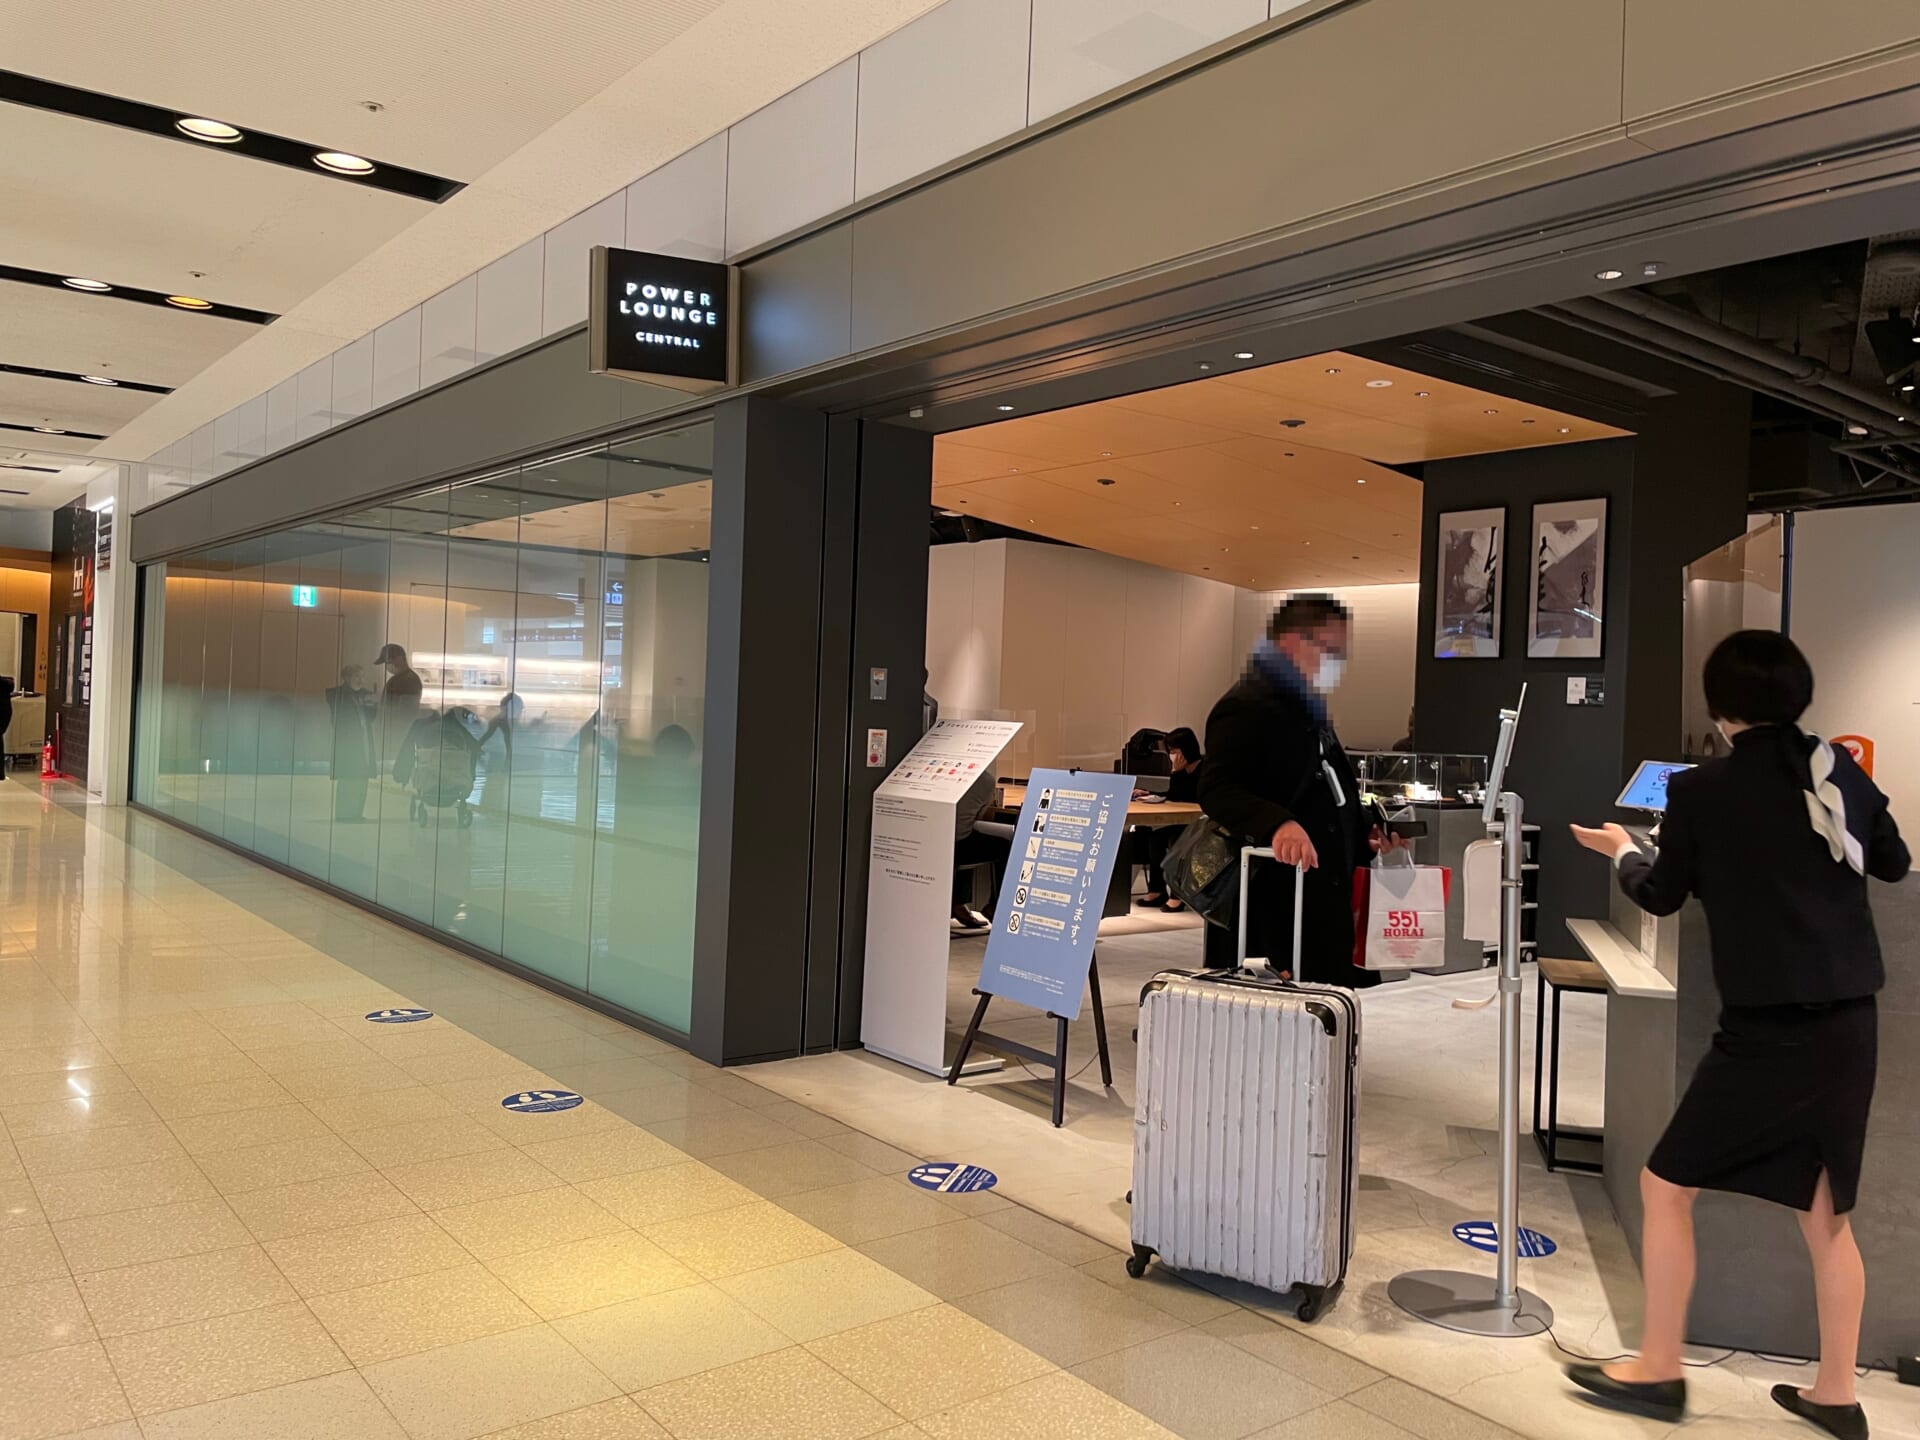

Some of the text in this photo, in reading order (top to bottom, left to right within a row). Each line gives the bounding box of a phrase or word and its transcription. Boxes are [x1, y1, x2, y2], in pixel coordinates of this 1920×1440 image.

[626, 282, 711, 306] POWER
[620, 300, 717, 325] LOUNGE
[635, 331, 701, 348] CENTRAL
[1388, 911, 1419, 928] 551
[1383, 928, 1425, 938] HORAI
